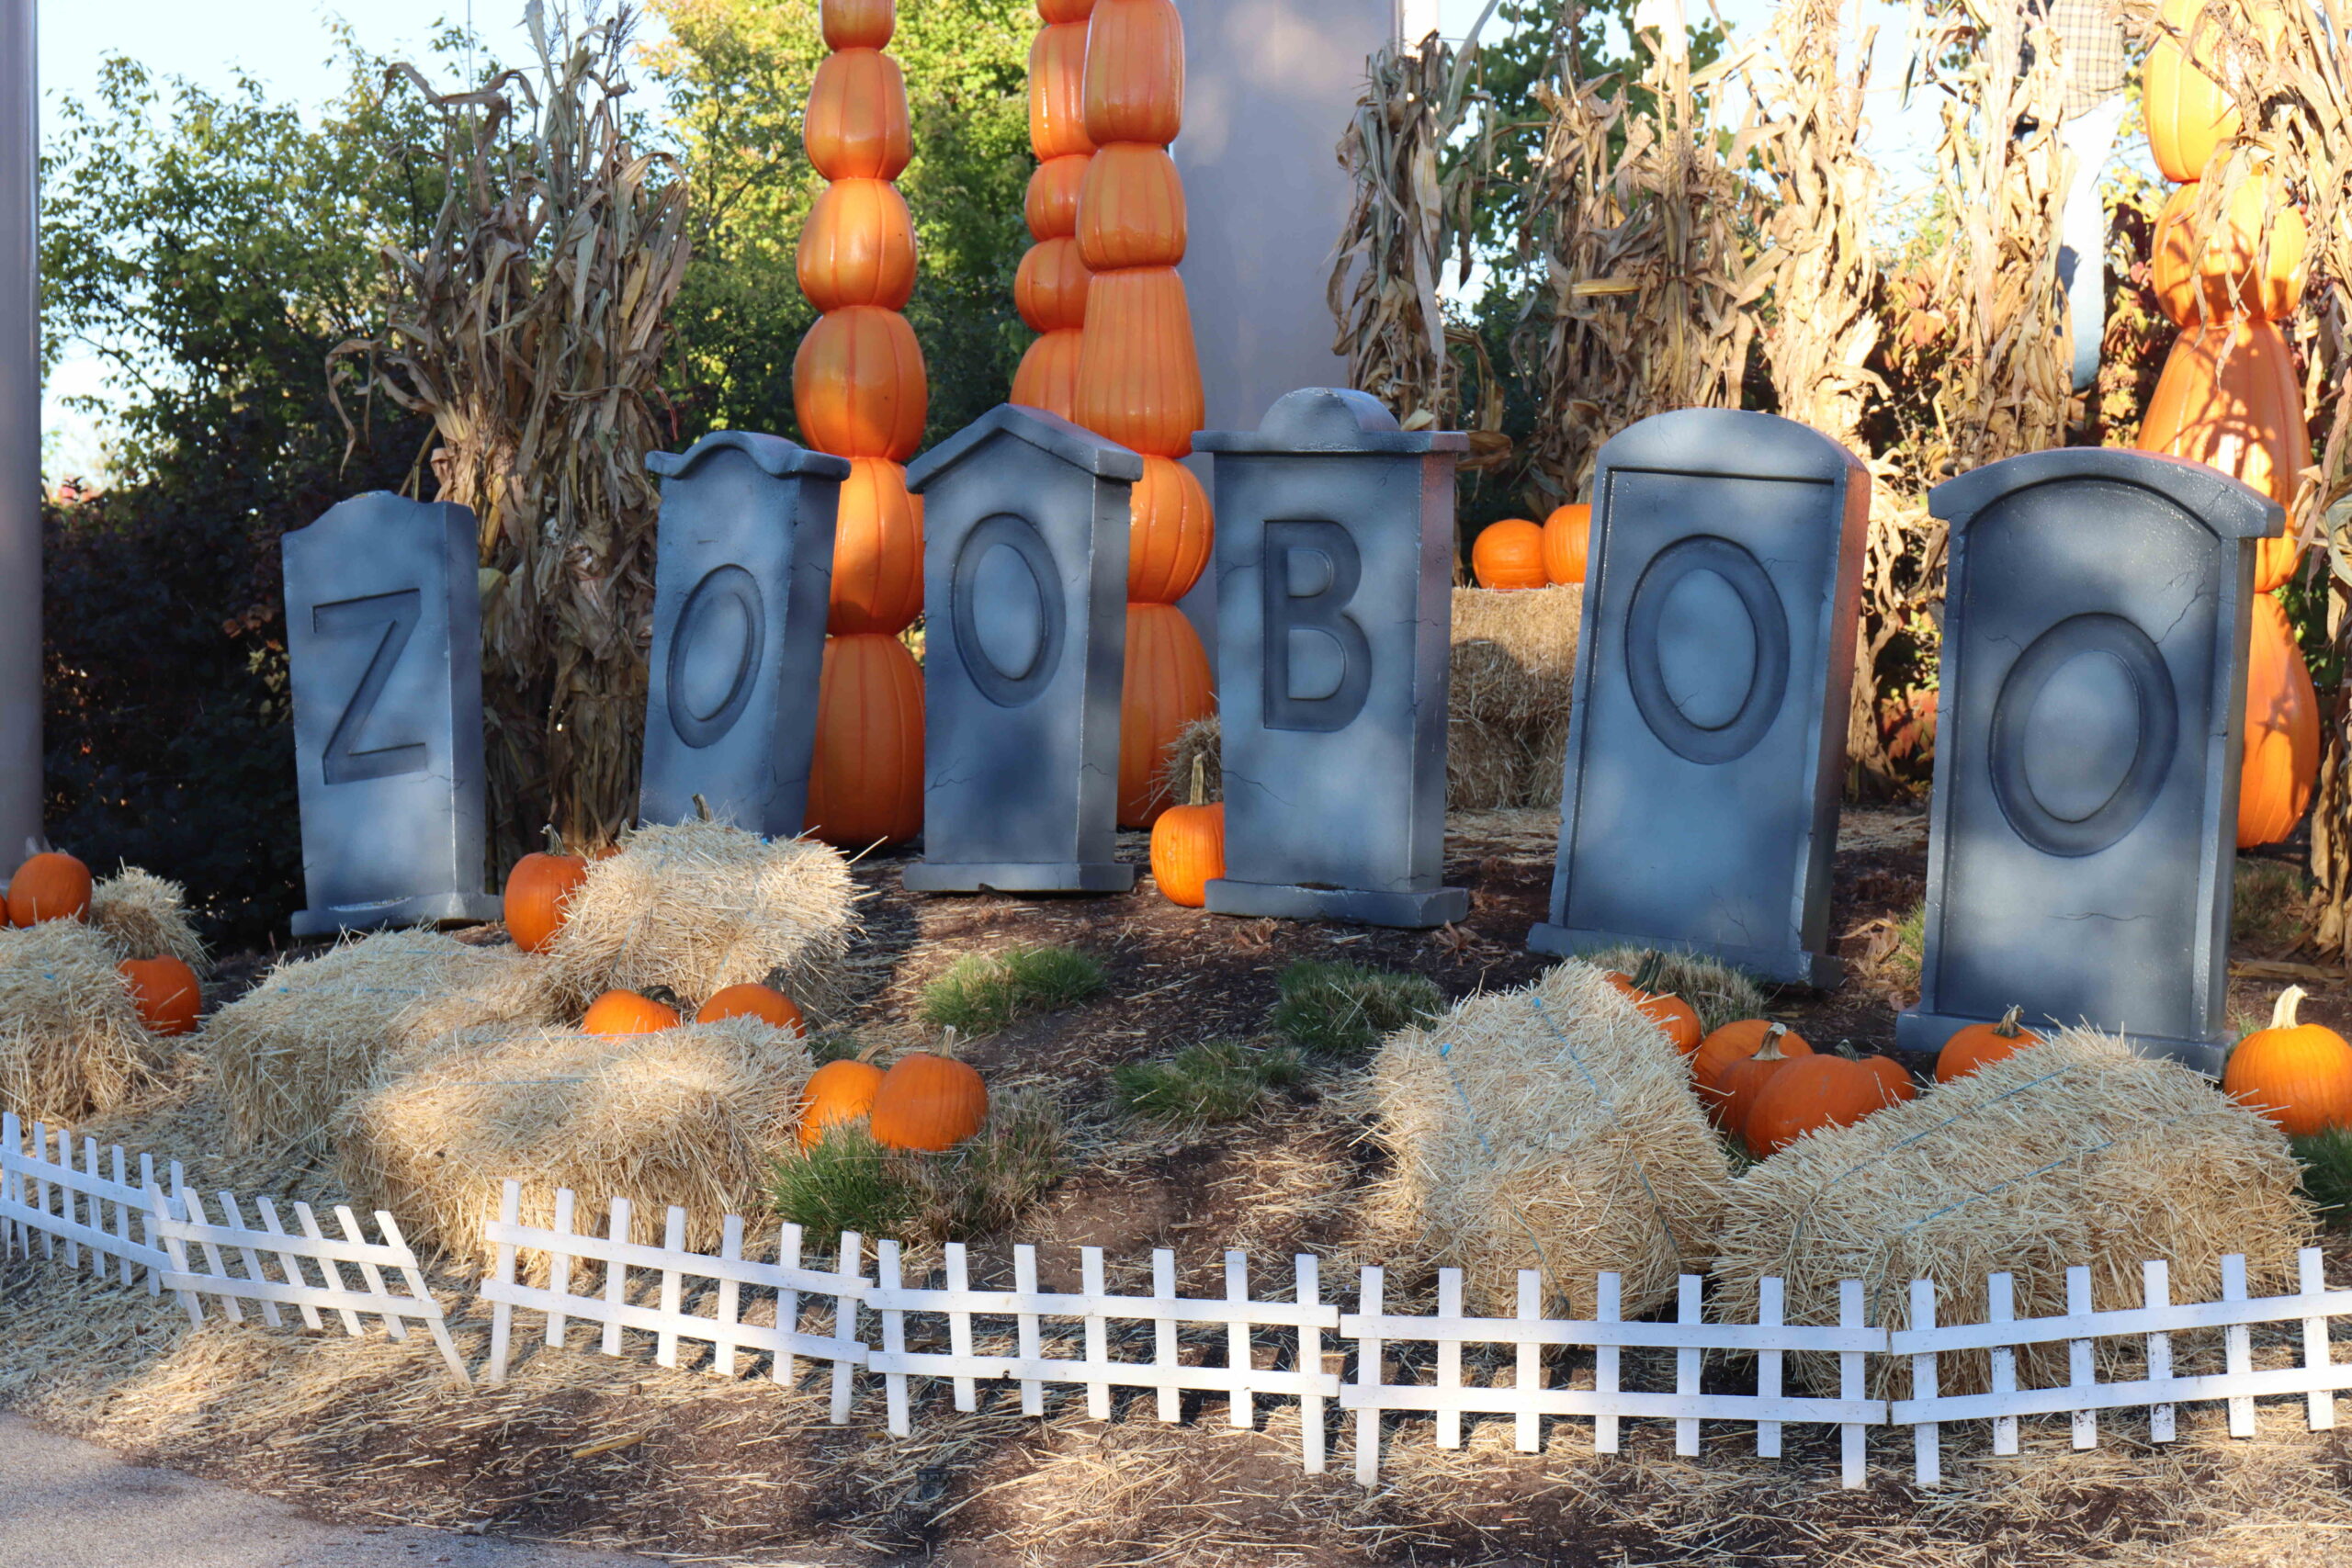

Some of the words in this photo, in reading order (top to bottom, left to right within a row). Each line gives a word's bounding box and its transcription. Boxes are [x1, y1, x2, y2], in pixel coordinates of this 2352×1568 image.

[312, 588, 427, 785] Z
[666, 563, 766, 749] O
[951, 512, 1067, 708] O
[1263, 519, 1373, 732] B
[1624, 535, 1790, 765] O
[1989, 613, 2179, 857] O
